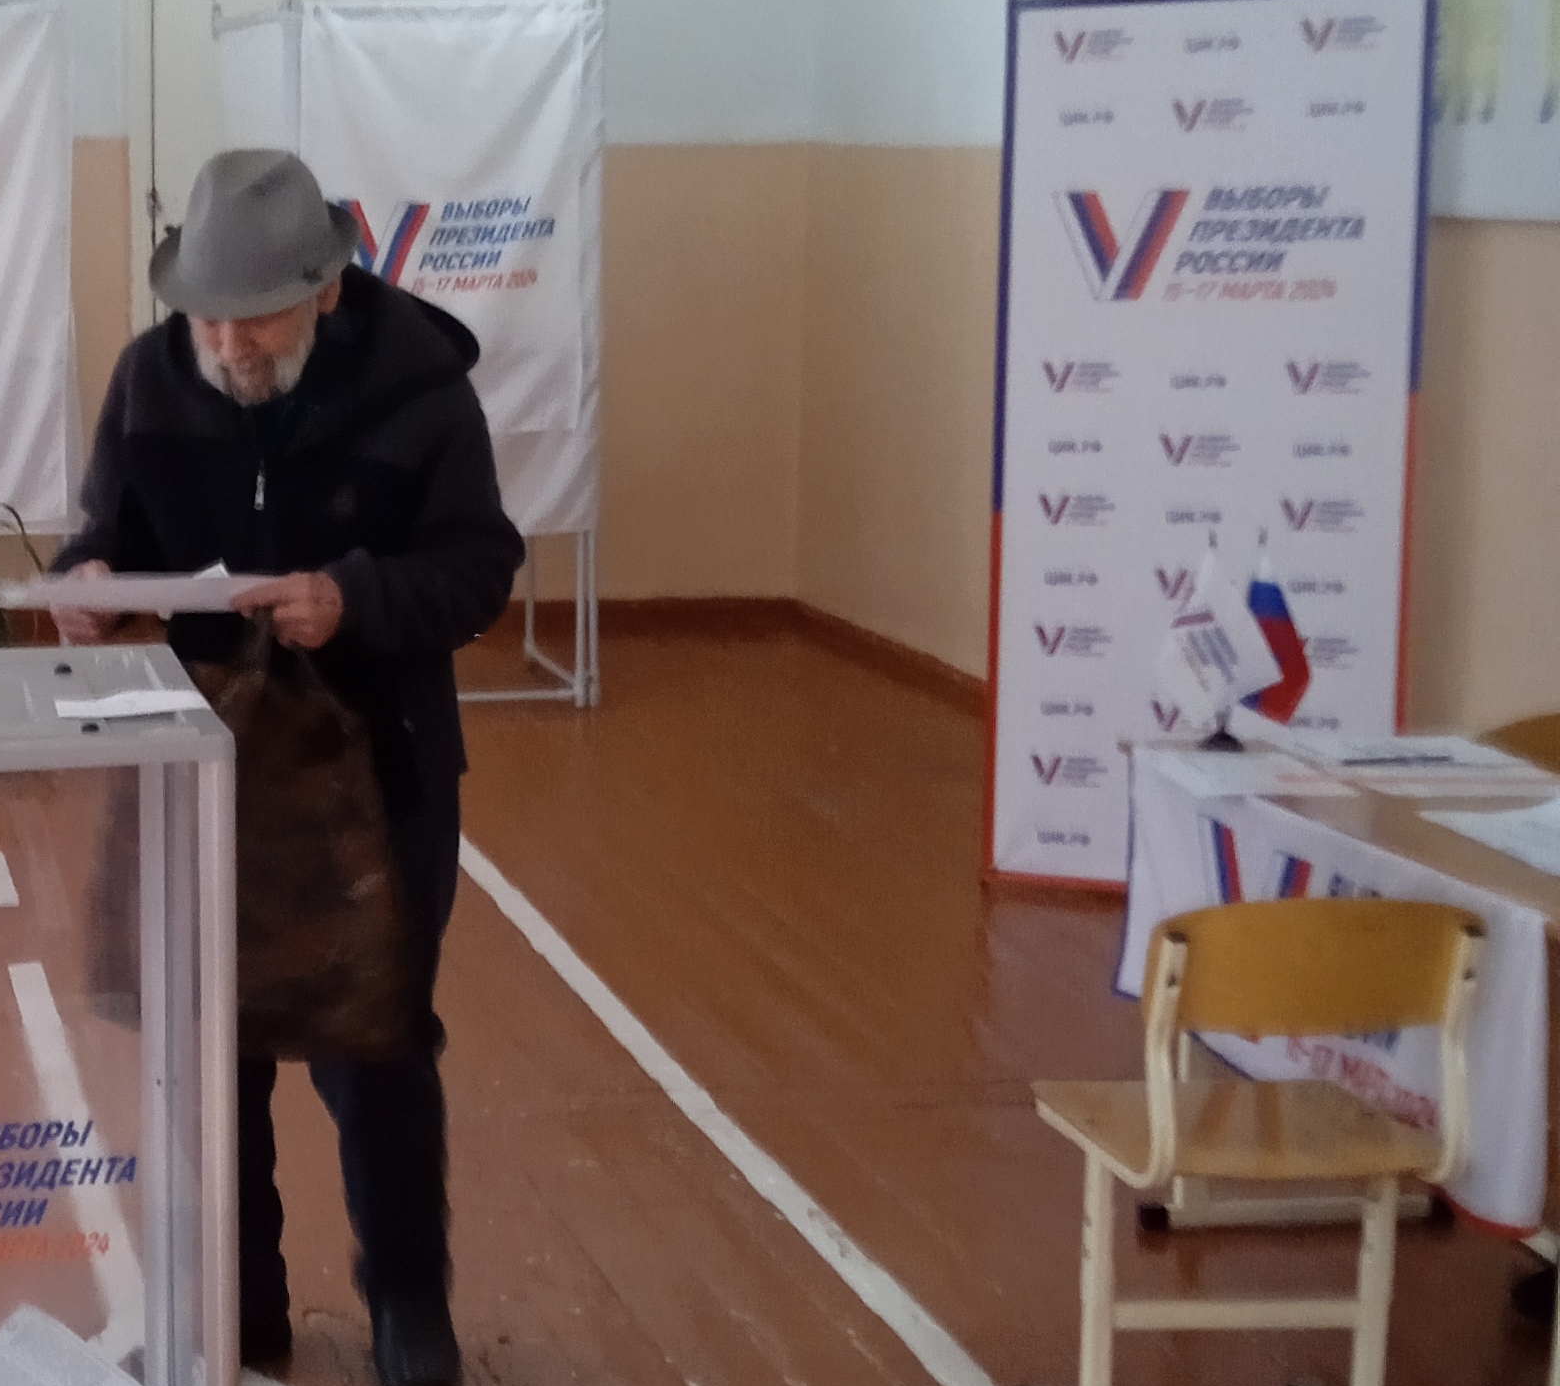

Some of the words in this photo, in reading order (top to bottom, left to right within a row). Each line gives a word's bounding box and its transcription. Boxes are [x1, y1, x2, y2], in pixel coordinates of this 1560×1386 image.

[441, 197, 531, 220] ВЫБОРЫ
[429, 219, 555, 246] ПРЕЗИДЕНТА
[419, 250, 502, 272] РОССИИ
